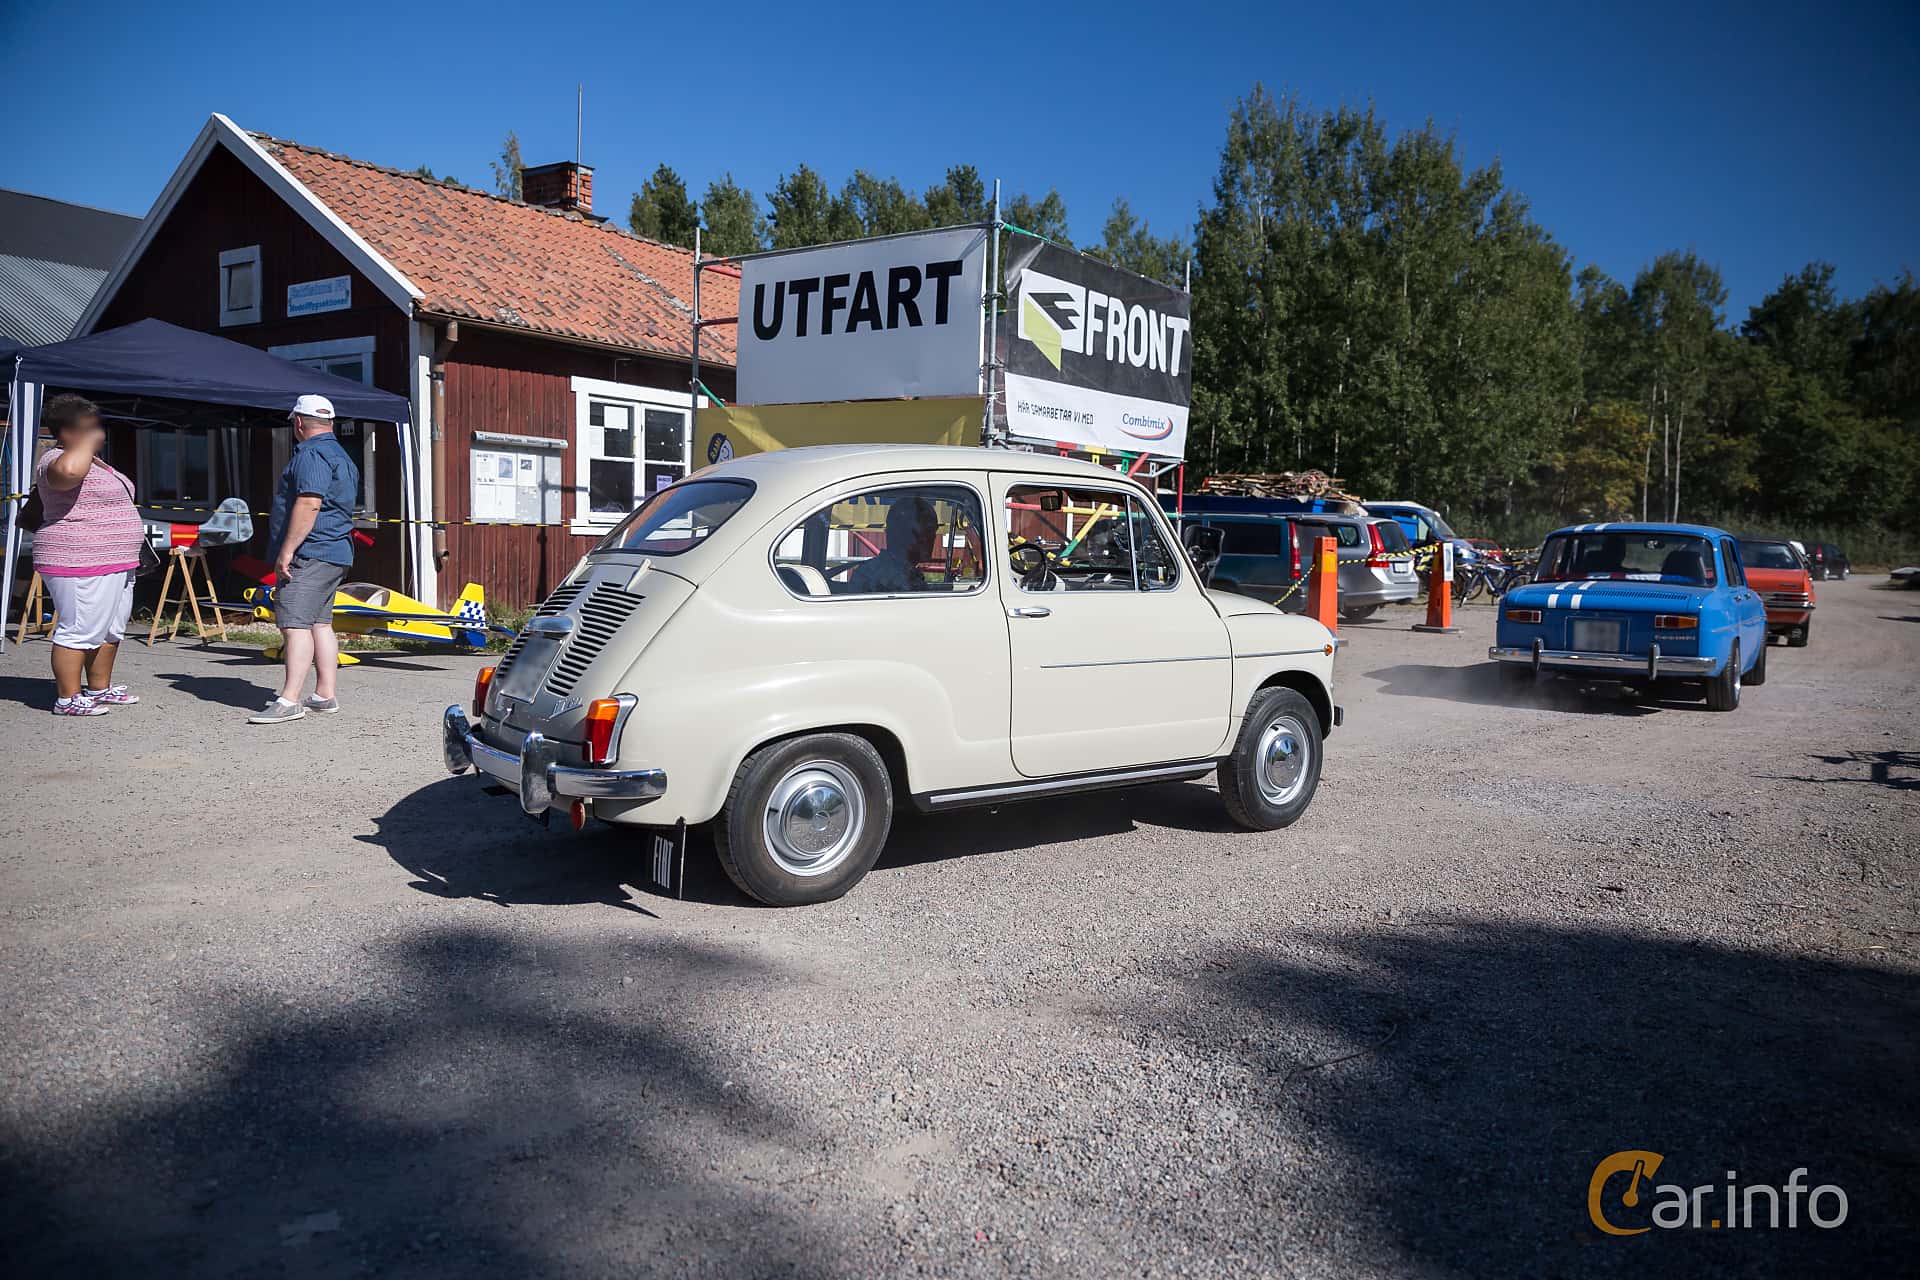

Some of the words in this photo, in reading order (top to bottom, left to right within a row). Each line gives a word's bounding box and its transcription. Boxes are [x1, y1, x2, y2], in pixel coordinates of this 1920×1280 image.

[753, 260, 963, 340] UTFART
[1086, 290, 1190, 376] FRONT
[1031, 403, 1072, 422] SAMARBETAR
[1073, 411, 1081, 423] VI
[1081, 413, 1094, 425] MED
[1122, 413, 1165, 430] Combimix
[653, 835, 673, 888] FIAT
